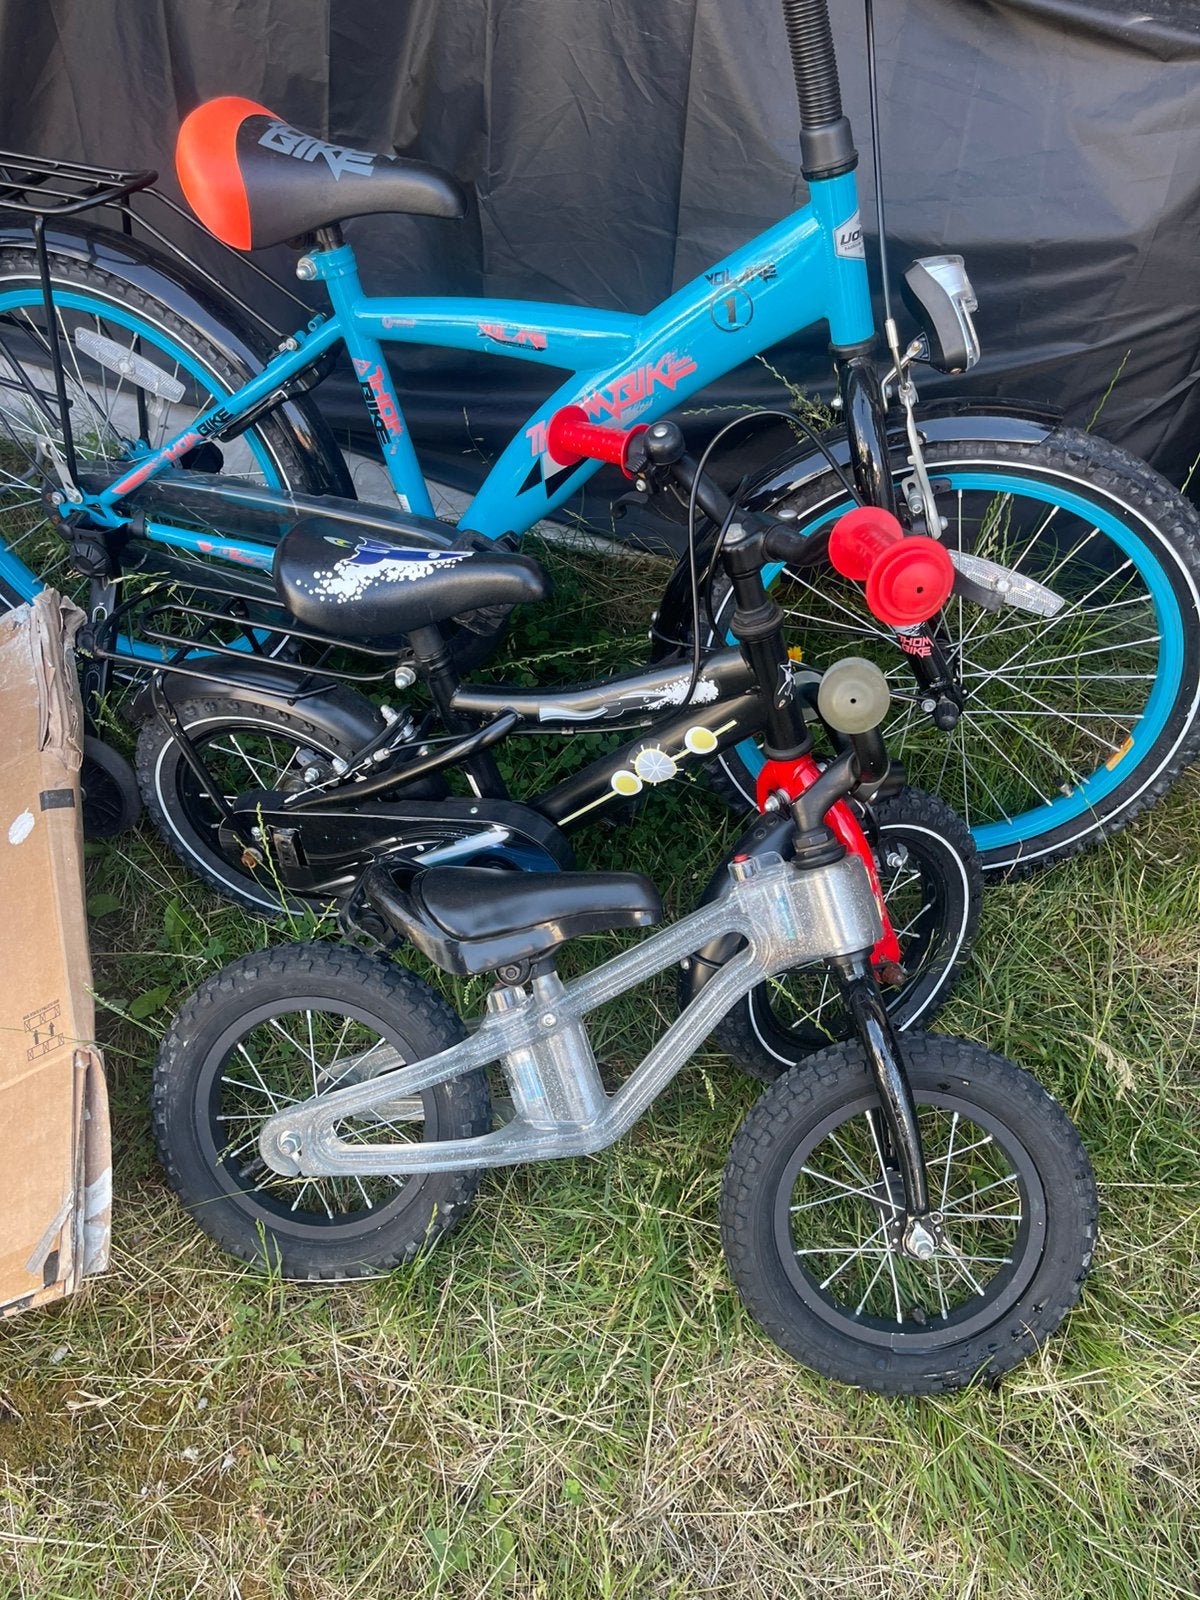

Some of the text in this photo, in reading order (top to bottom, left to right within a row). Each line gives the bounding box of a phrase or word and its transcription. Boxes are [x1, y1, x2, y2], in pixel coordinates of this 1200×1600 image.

[258, 125, 378, 182] BIKE
[722, 296, 737, 324] 1
[196, 406, 235, 438] BIKE
[897, 632, 935, 648] THOM
[901, 643, 932, 658] BIKE
